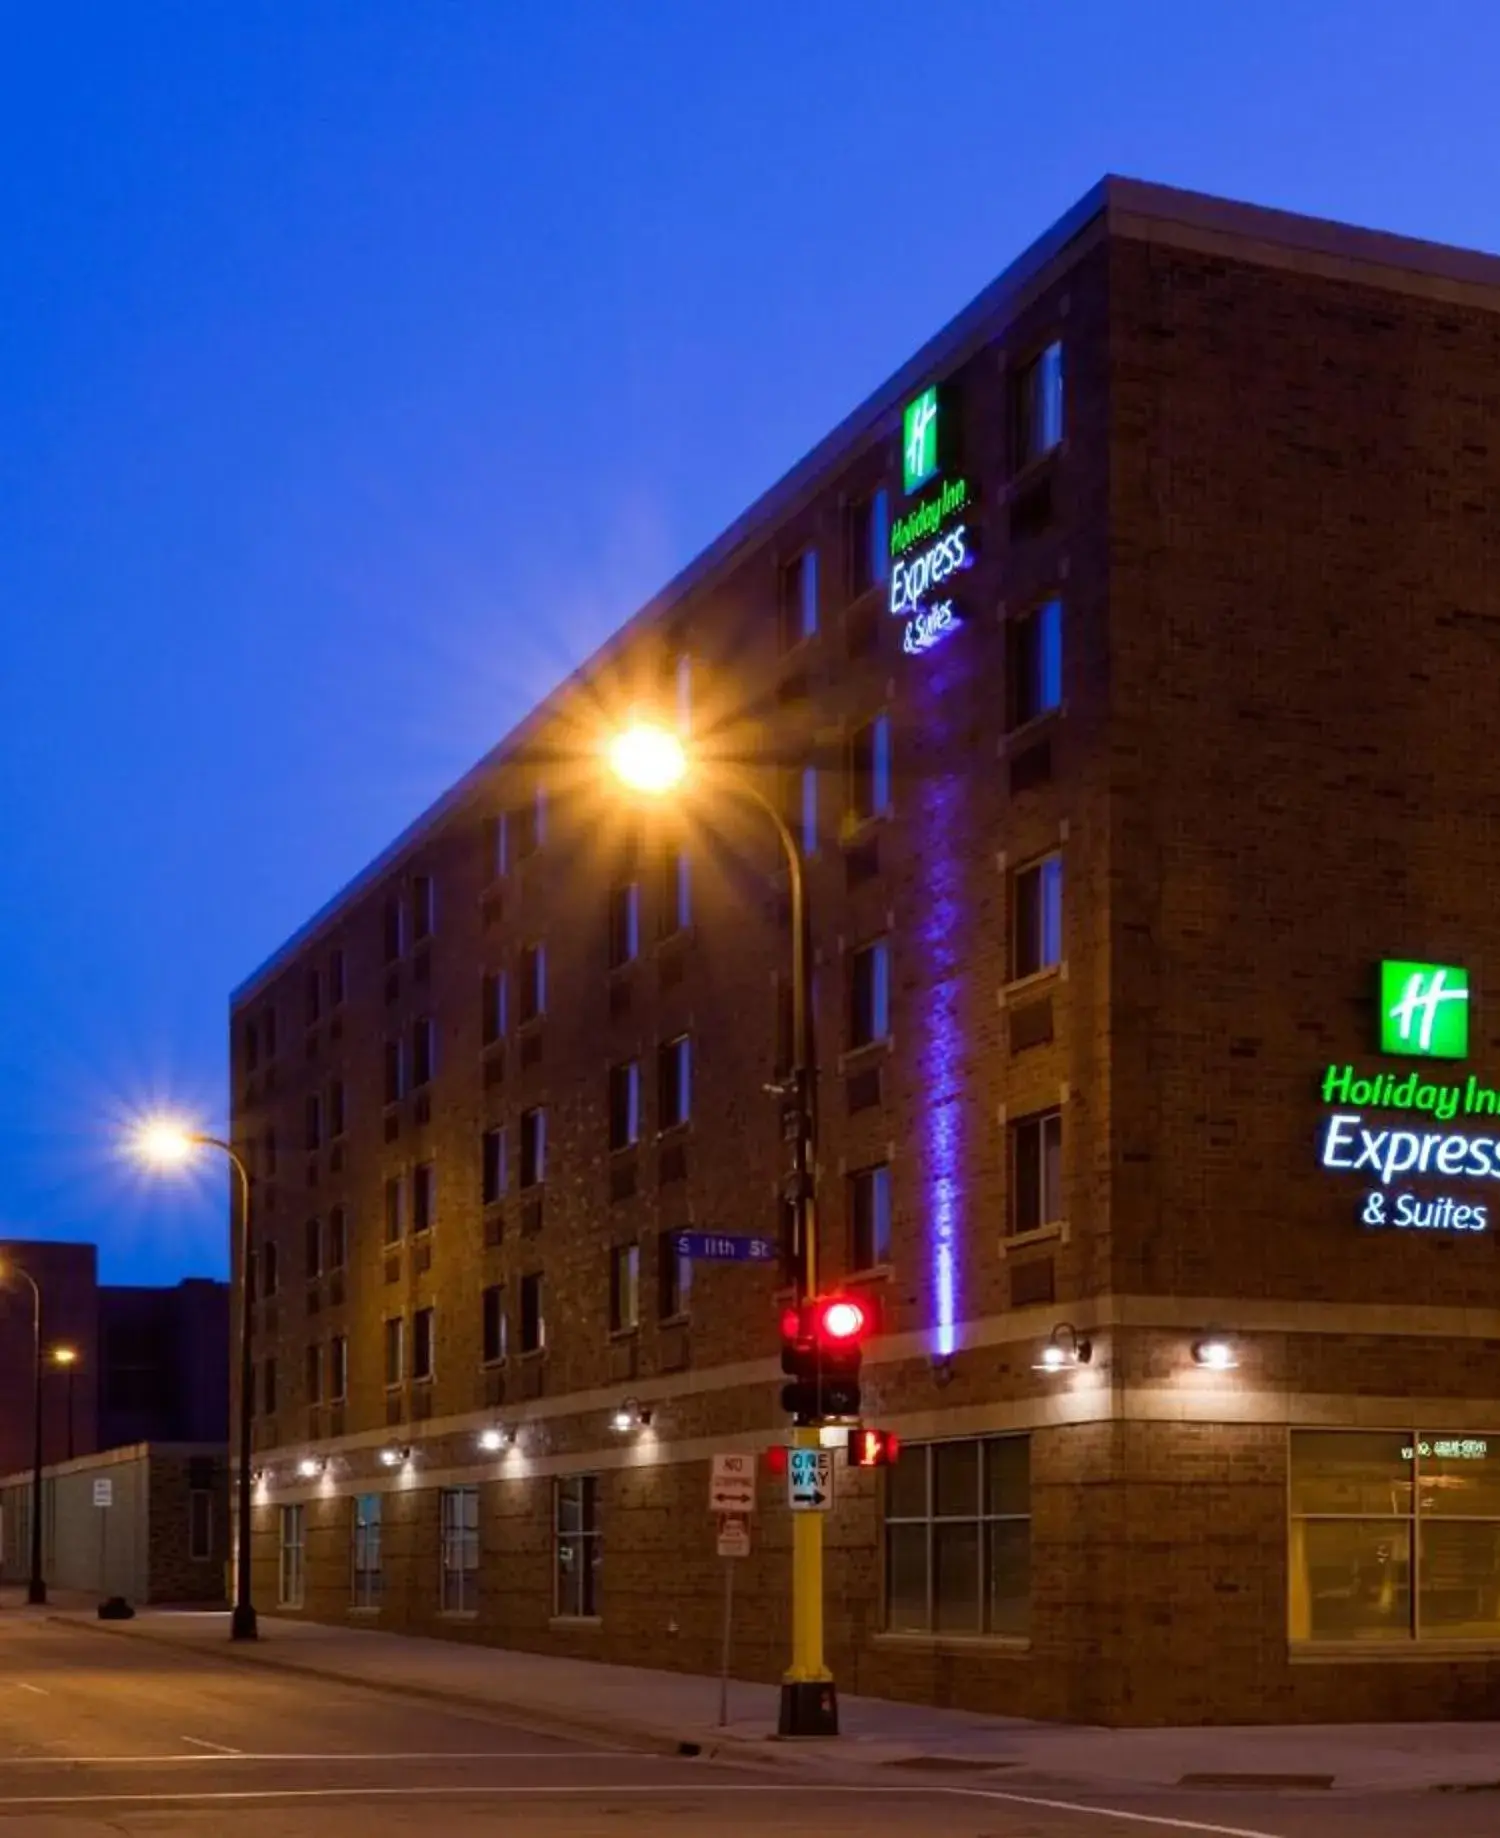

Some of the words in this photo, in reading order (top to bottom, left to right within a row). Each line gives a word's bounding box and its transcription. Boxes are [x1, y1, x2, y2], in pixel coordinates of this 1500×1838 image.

[891, 497, 941, 556] Holiday
[942, 479, 966, 515] Inn
[890, 525, 966, 615] Express
[904, 620, 915, 652] &
[915, 599, 953, 643] Suites
[1321, 1064, 1460, 1120] Holiday
[1362, 1191, 1386, 1224] &
[1393, 1195, 1488, 1231] Suites
[679, 1237, 690, 1254] S
[704, 1239, 735, 1257] 11th
[750, 1240, 770, 1257] St
[723, 1458, 743, 1472] NO
[791, 1454, 828, 1469] ONE
[791, 1472, 829, 1486] WAY
